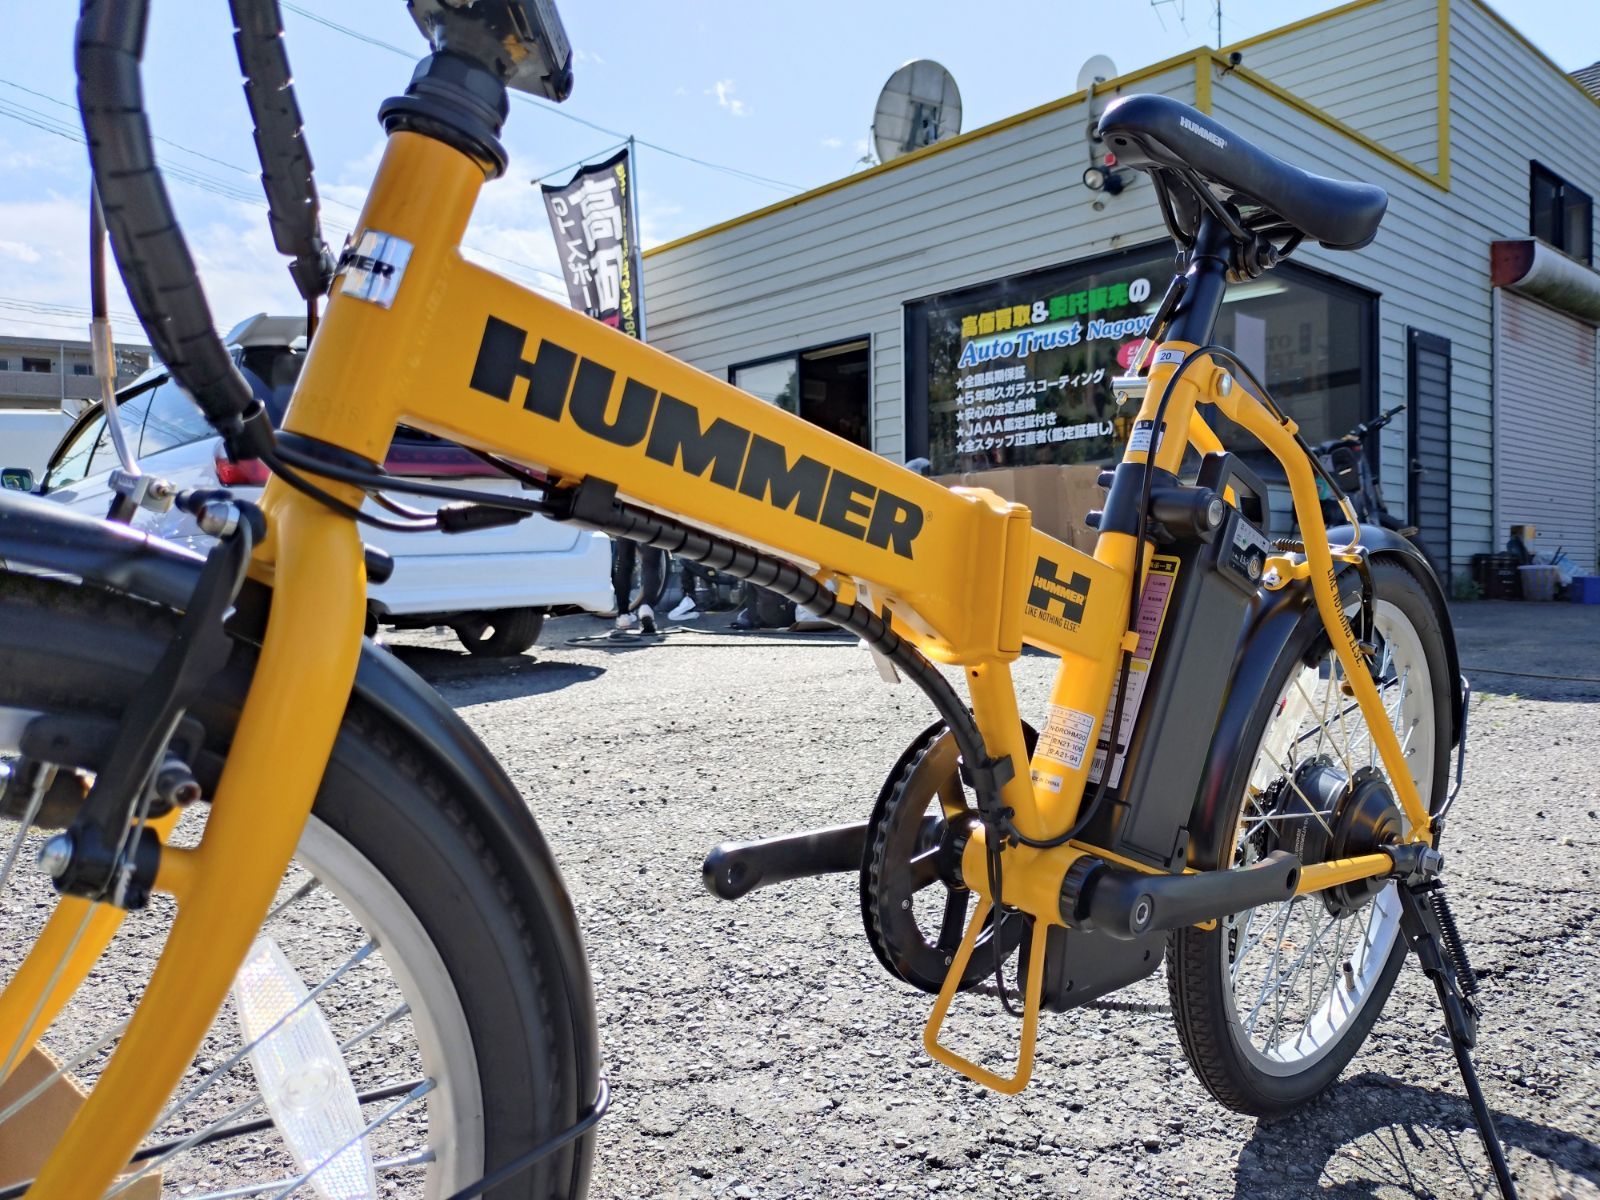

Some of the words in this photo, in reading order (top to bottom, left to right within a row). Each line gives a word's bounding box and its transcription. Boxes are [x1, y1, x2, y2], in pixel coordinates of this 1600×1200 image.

[1180, 115, 1225, 149] HUMMER
[1160, 352, 1171, 360] 20
[469, 314, 925, 561] HUMMER
[1034, 576, 1086, 606] HUMMER
[1327, 567, 1338, 593] LIKE
[1333, 592, 1352, 638] NOTHING
[1025, 605, 1038, 618] LIKE
[1039, 609, 1063, 628] NOTHING
